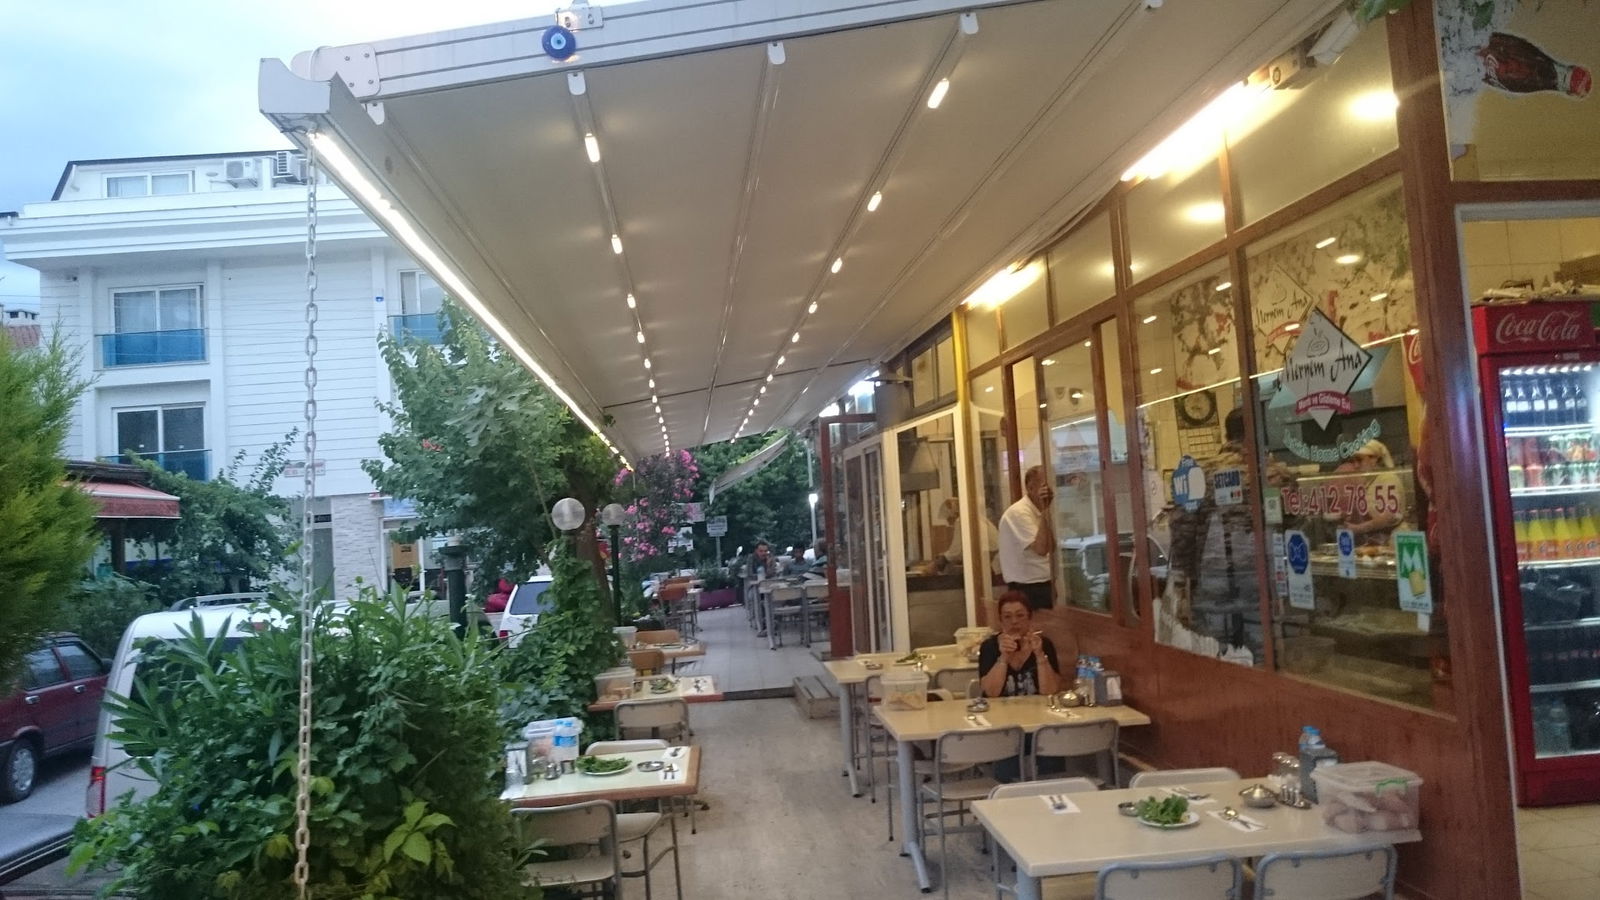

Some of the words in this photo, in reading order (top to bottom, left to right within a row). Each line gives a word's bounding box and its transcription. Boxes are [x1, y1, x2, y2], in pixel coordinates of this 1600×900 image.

[1495, 310, 1582, 344] Coca-Cola
[1330, 336, 1362, 382] Ana
[1310, 445, 1339, 463] Home
[1345, 485, 1368, 515] 78
[1374, 483, 1400, 514] 55
